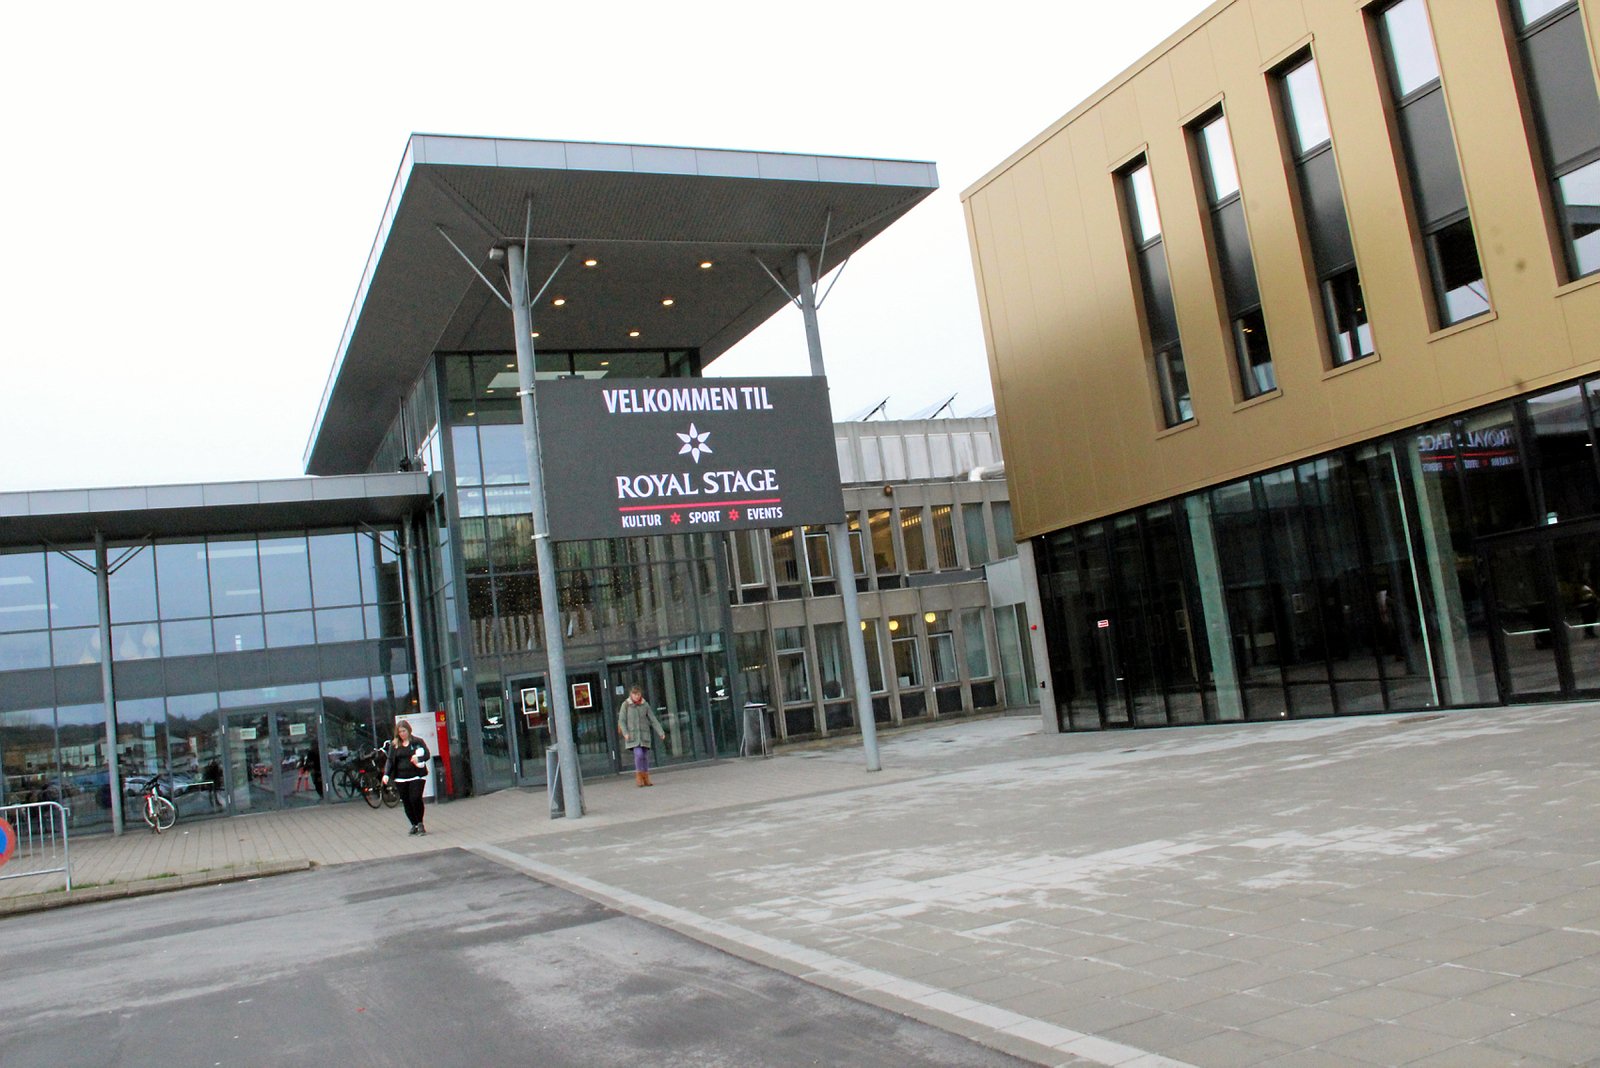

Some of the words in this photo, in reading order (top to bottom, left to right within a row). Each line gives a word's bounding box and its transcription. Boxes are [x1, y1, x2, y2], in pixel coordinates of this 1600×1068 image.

[602, 387, 738, 413] VELKOMMEN
[740, 386, 774, 410] TIL
[616, 473, 699, 499] ROYAL
[703, 468, 779, 494] STAGE
[621, 514, 663, 528] KULTUR
[688, 510, 721, 525] SPORT
[747, 506, 783, 521] EVENTS
